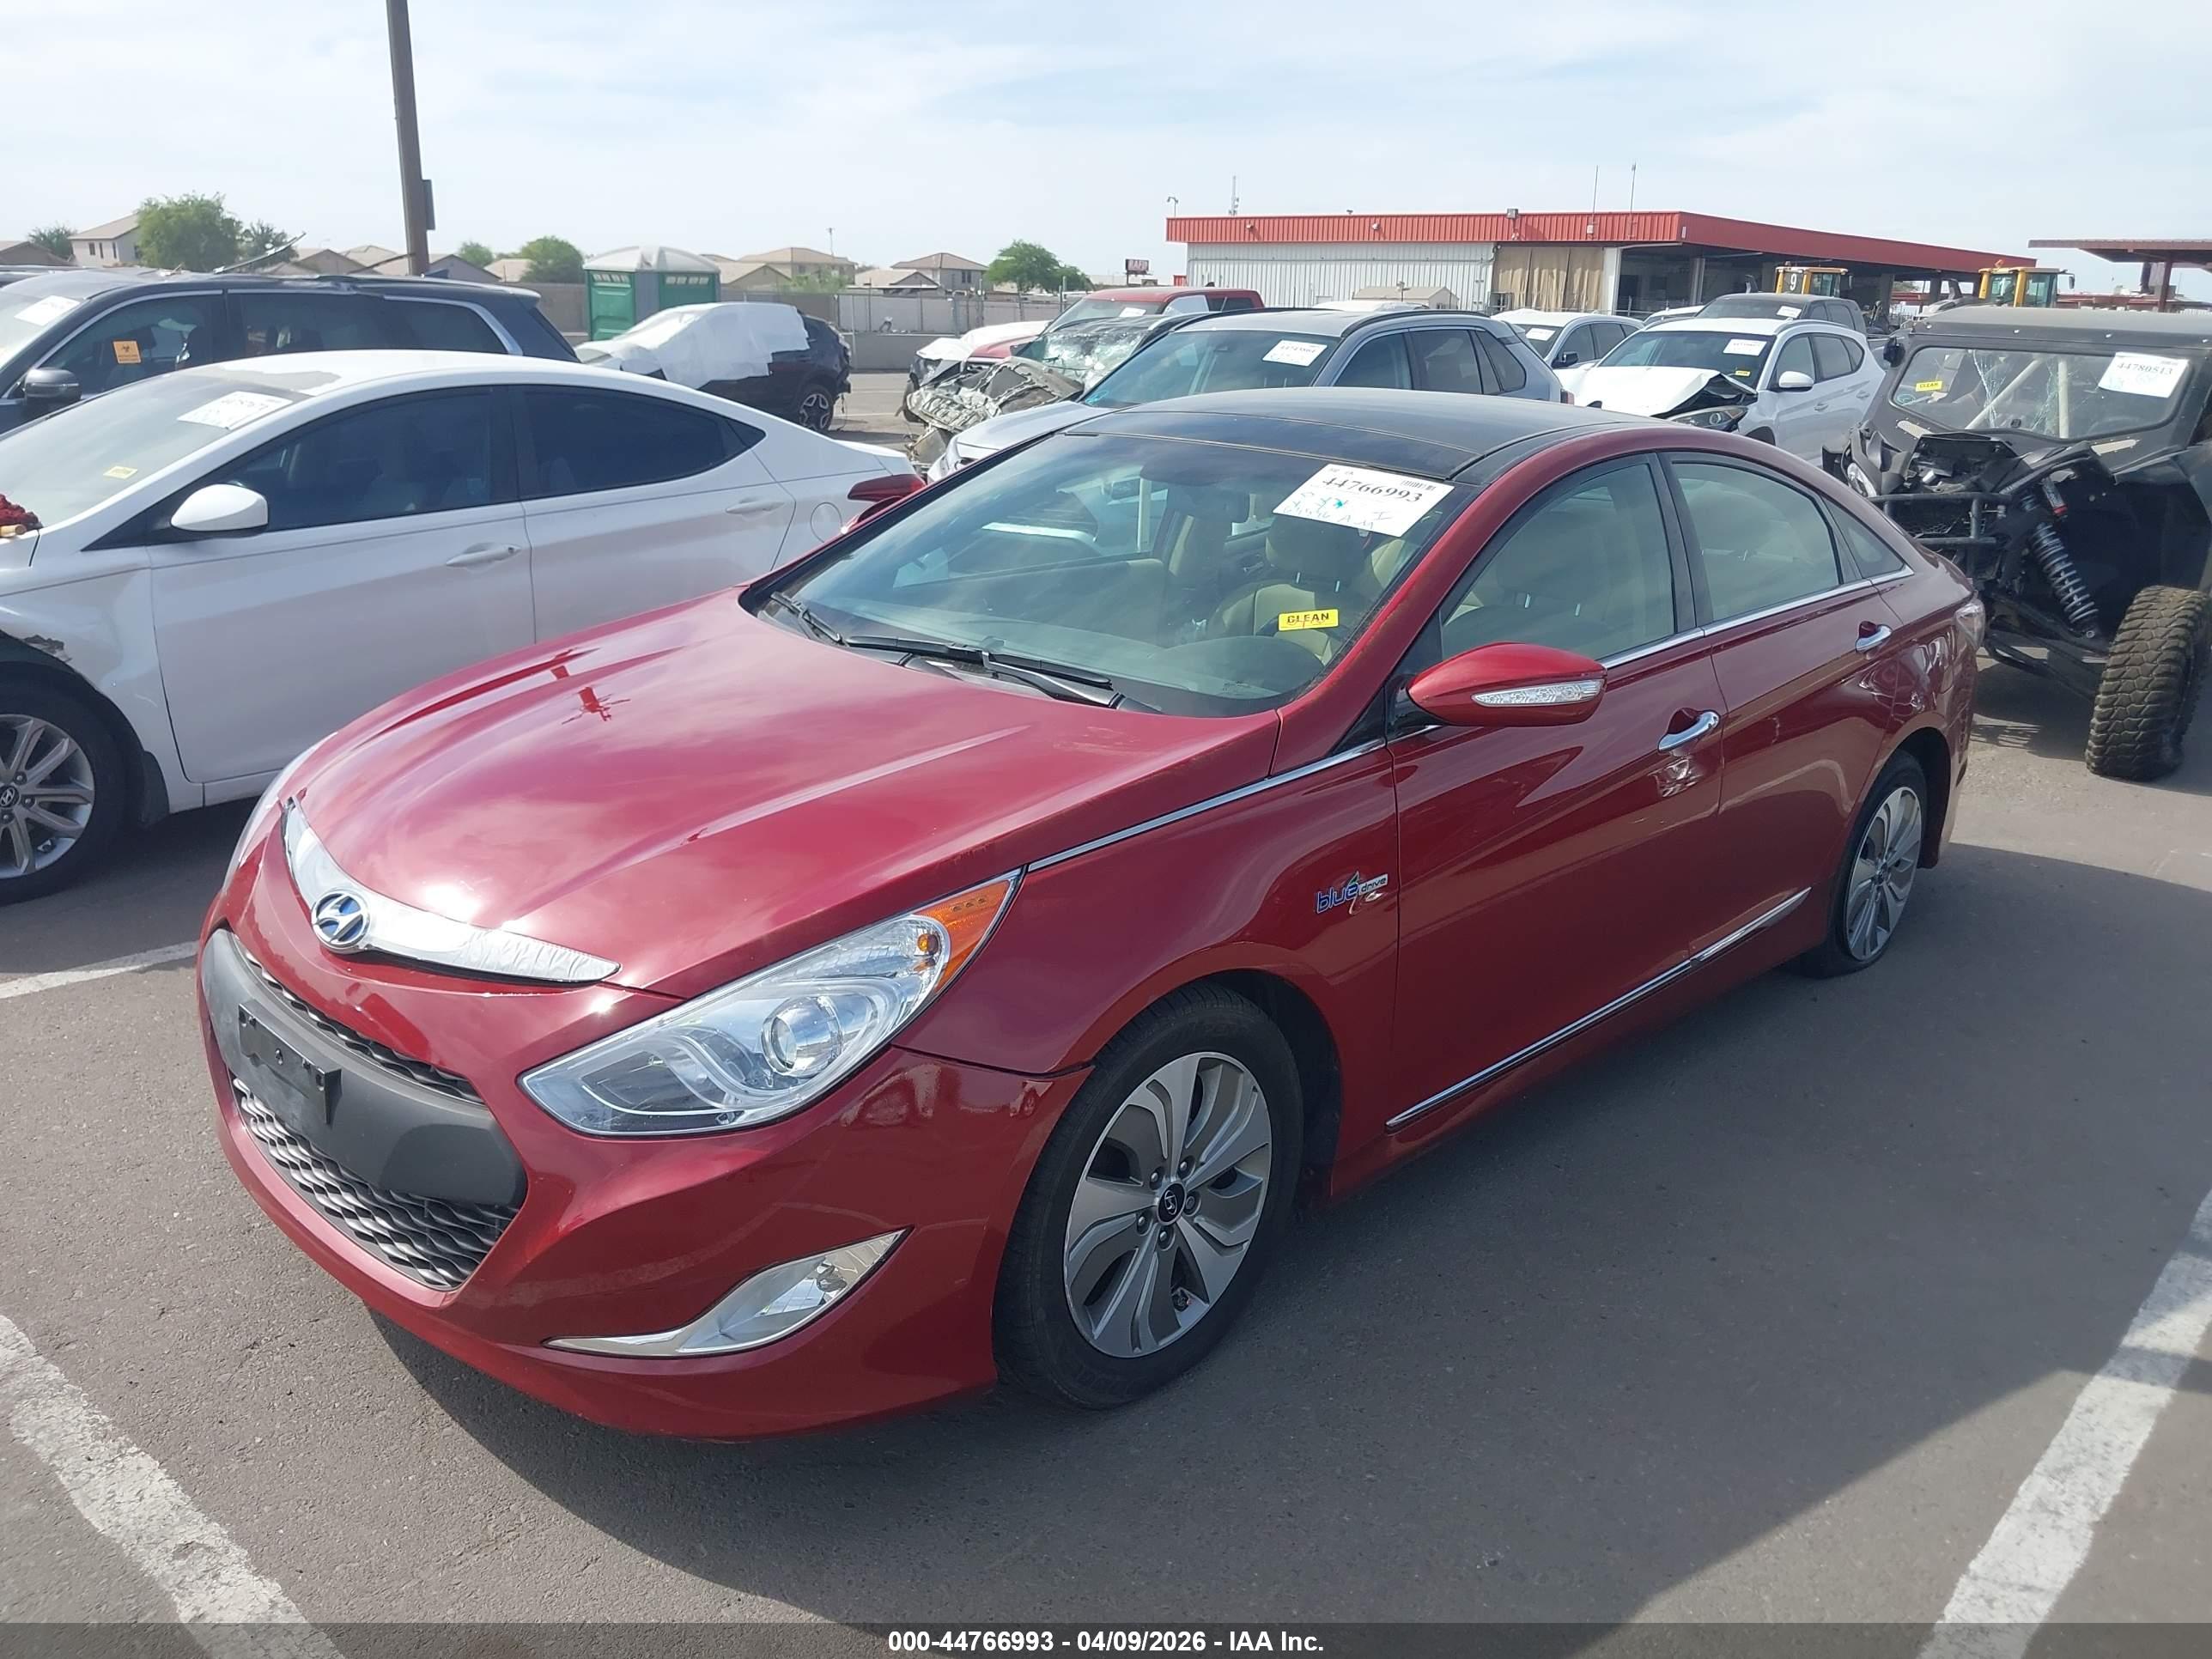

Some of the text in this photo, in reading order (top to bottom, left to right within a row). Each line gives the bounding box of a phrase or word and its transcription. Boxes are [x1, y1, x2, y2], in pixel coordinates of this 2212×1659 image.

[1790, 273, 1797, 291] 9
[1322, 477, 1423, 503] 44766993
[1287, 612, 1329, 623] CLEAN
[1316, 877, 1387, 915] blue drive
